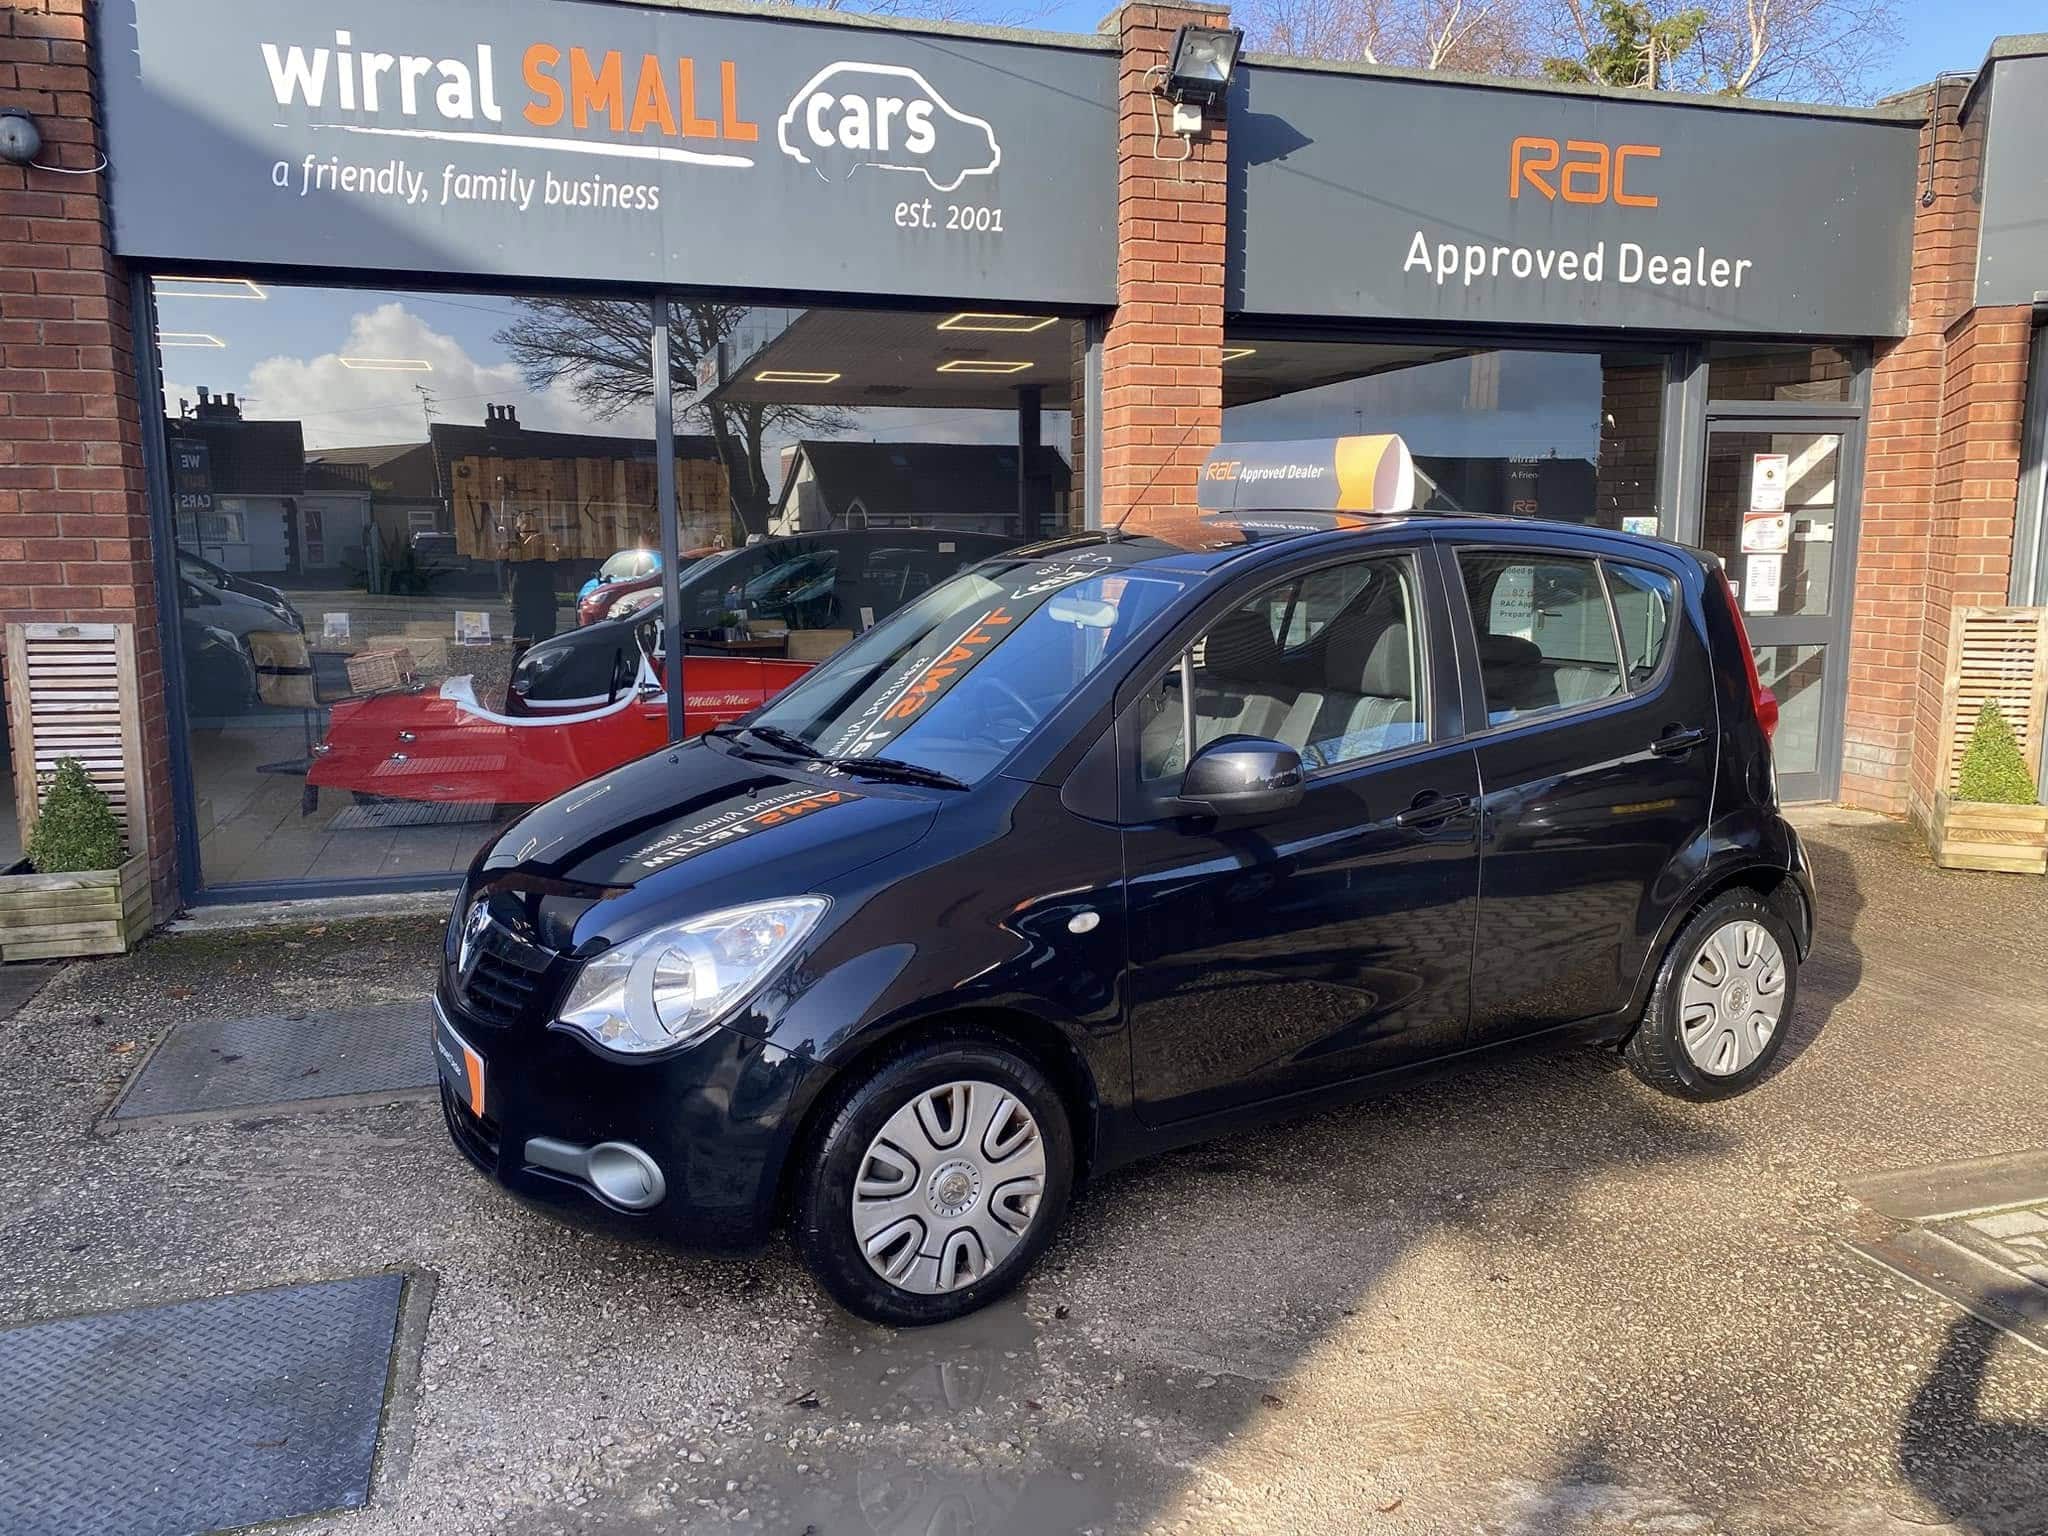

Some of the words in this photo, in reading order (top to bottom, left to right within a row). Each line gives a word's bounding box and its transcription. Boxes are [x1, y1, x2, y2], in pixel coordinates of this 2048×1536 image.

[261, 29, 502, 122] wirral
[522, 42, 759, 141] SMALL
[806, 91, 936, 154] cars
[271, 160, 289, 187] a
[300, 154, 429, 204] friendly,
[440, 164, 535, 211] family
[544, 171, 659, 210] business
[895, 198, 936, 228] est.
[946, 204, 1003, 232] 2001
[1403, 231, 1604, 285] Approved
[1619, 242, 1753, 288] Dealer
[1239, 464, 1286, 482] Approved
[1288, 463, 1325, 480] Dealer
[688, 696, 721, 707] Millie
[723, 694, 750, 705] Mac
